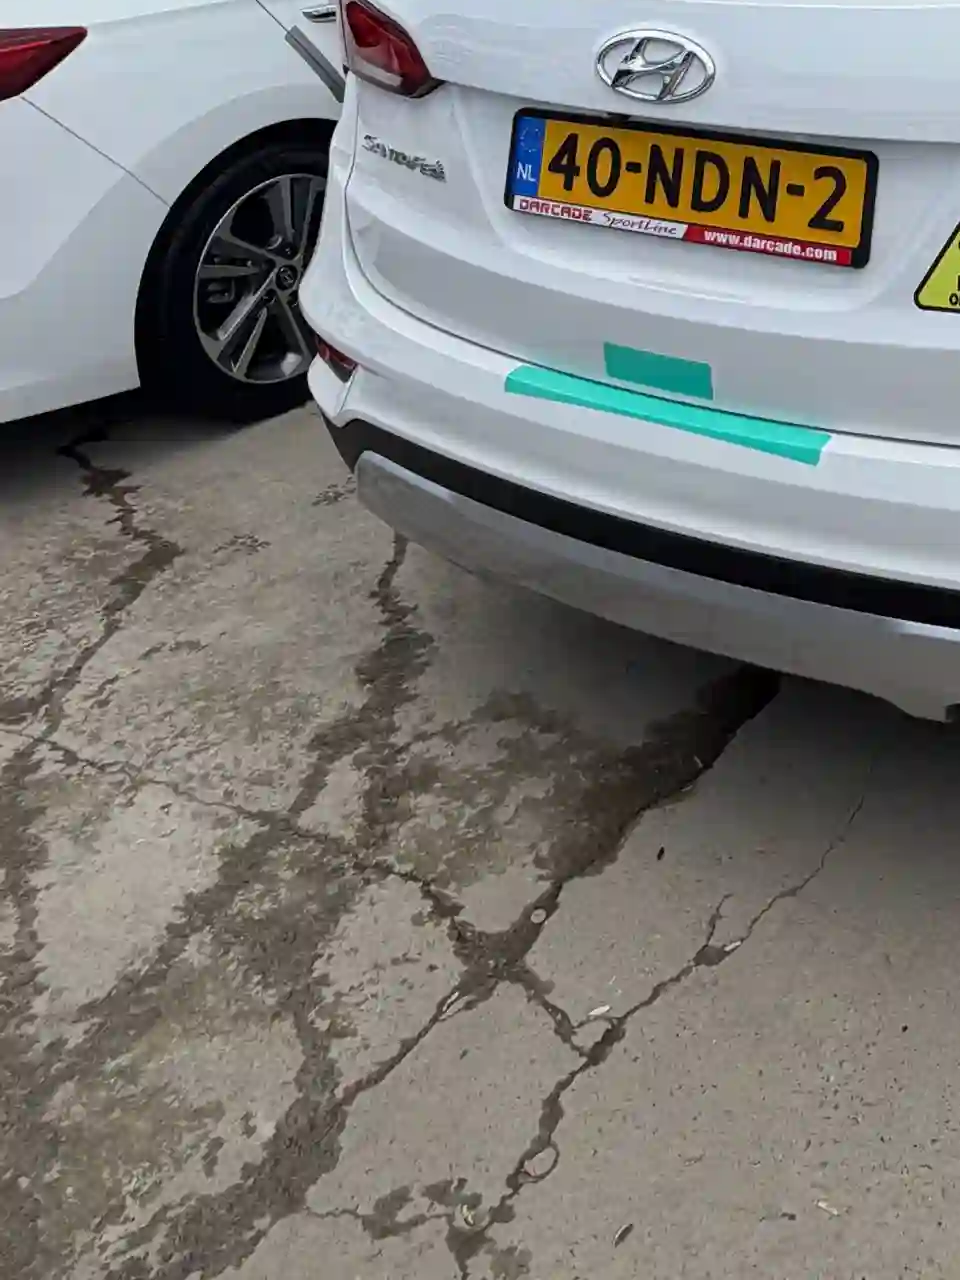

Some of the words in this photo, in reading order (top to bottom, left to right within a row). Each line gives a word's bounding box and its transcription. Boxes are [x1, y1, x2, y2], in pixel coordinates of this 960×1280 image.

[516, 160, 537, 182] NL
[547, 132, 847, 233] 40-NDN-2
[519, 198, 593, 221] DARCADE
[704, 229, 838, 261] www.darcade.com
